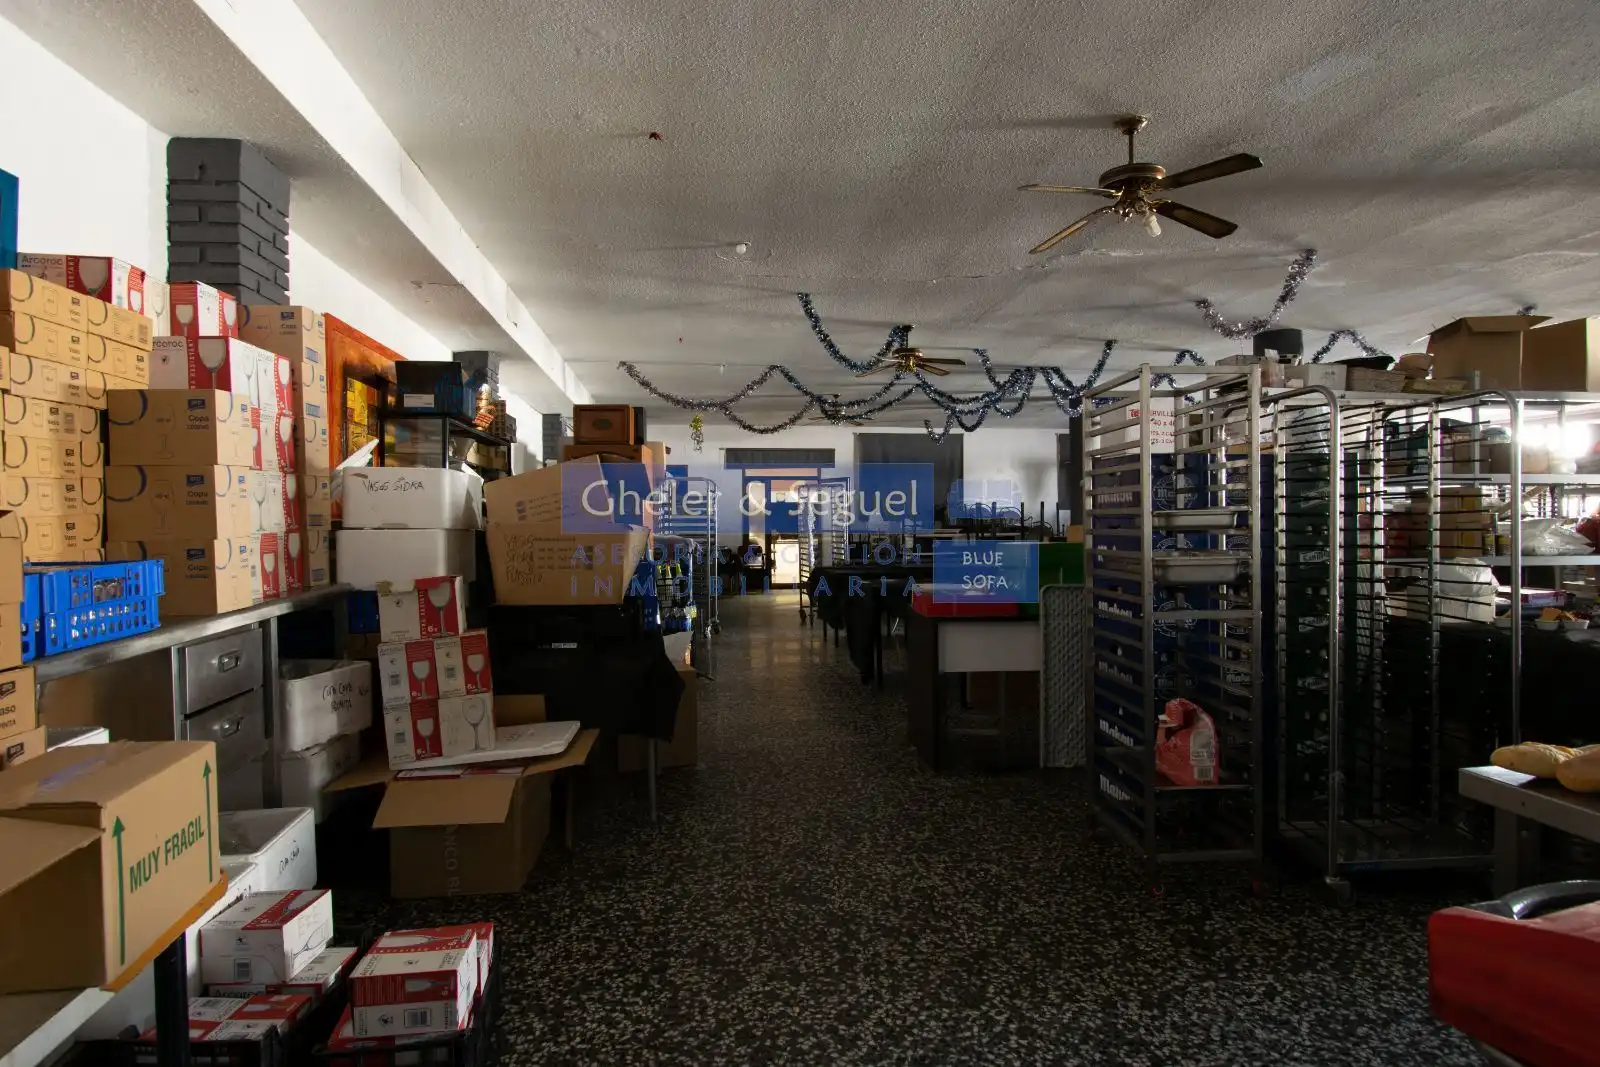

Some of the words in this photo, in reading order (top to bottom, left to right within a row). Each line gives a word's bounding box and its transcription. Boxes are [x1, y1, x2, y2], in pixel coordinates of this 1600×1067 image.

[22, 256, 63, 266] Arcoroc
[392, 480, 424, 492] SIDRA
[129, 846, 161, 894] MUY
[164, 815, 205, 867] FRAGIL
